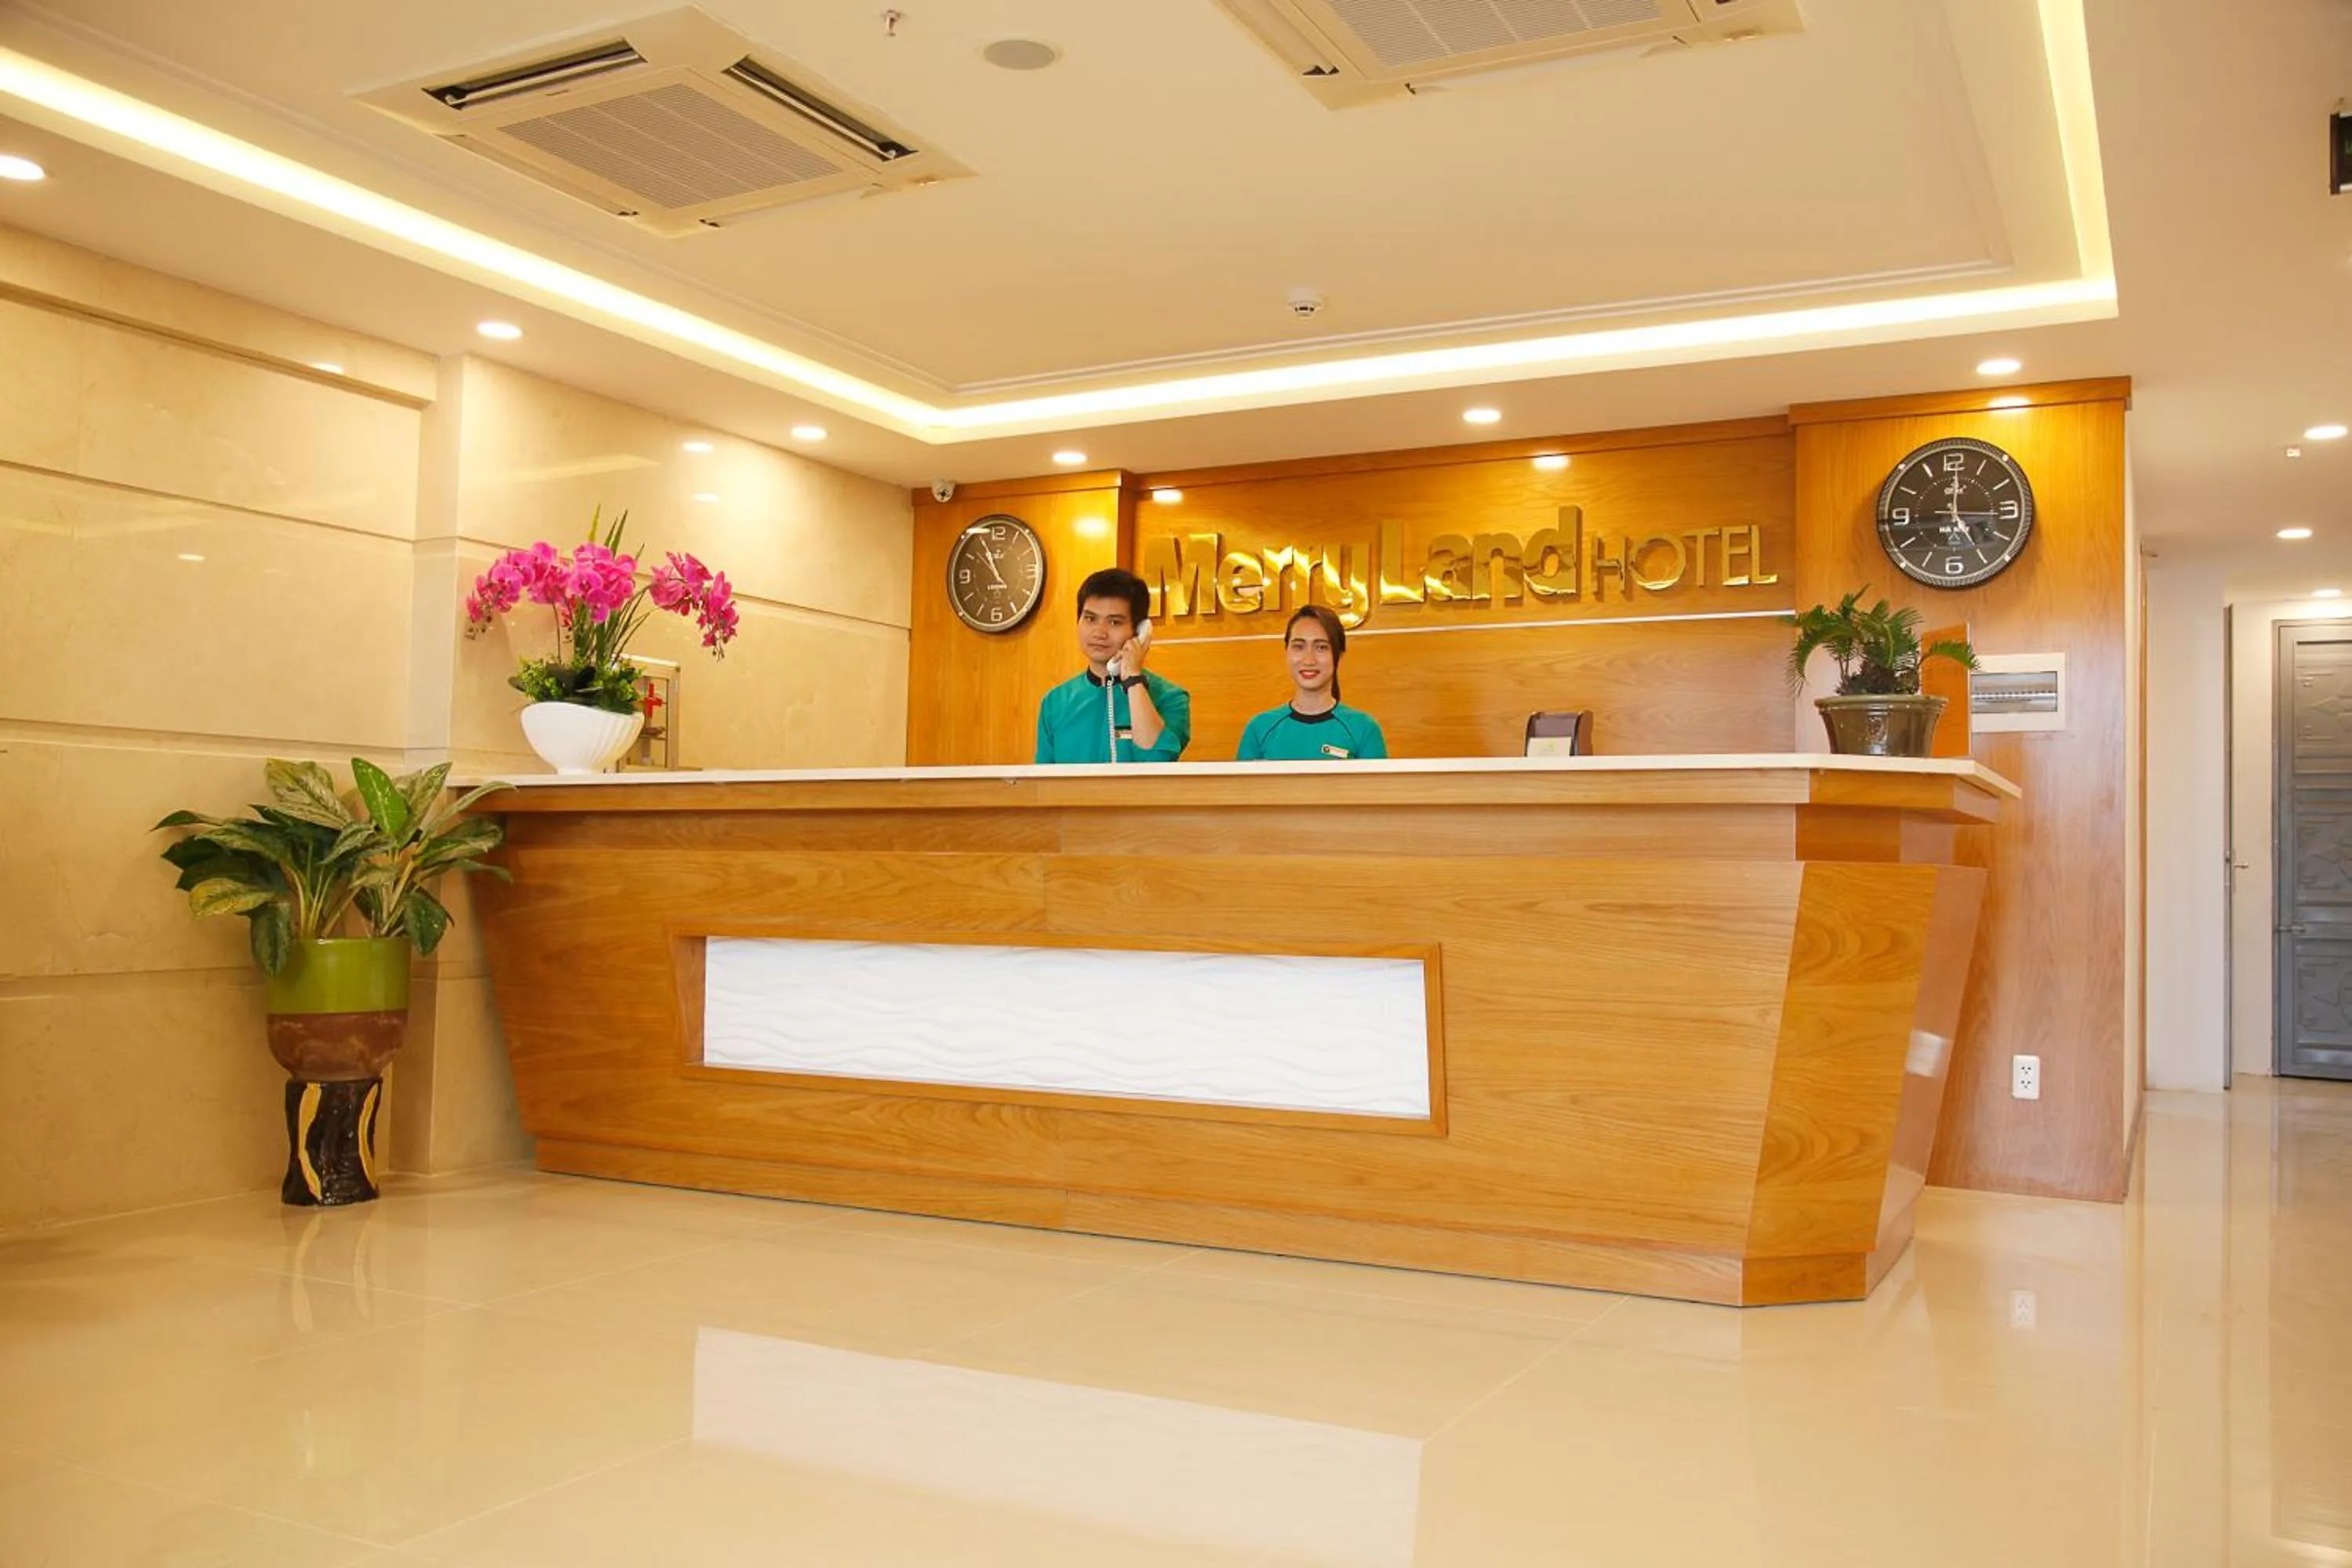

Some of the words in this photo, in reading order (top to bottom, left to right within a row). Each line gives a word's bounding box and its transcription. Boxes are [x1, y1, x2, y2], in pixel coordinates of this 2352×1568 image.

[1944, 452, 1965, 471] 12
[1892, 507, 1911, 526] 9
[1998, 499, 2019, 520] 3
[992, 526, 1006, 540] 12
[1592, 524, 1778, 593] HOTEL
[1944, 556, 1964, 575] 6
[959, 569, 971, 584] 9
[990, 607, 1003, 622] 6
